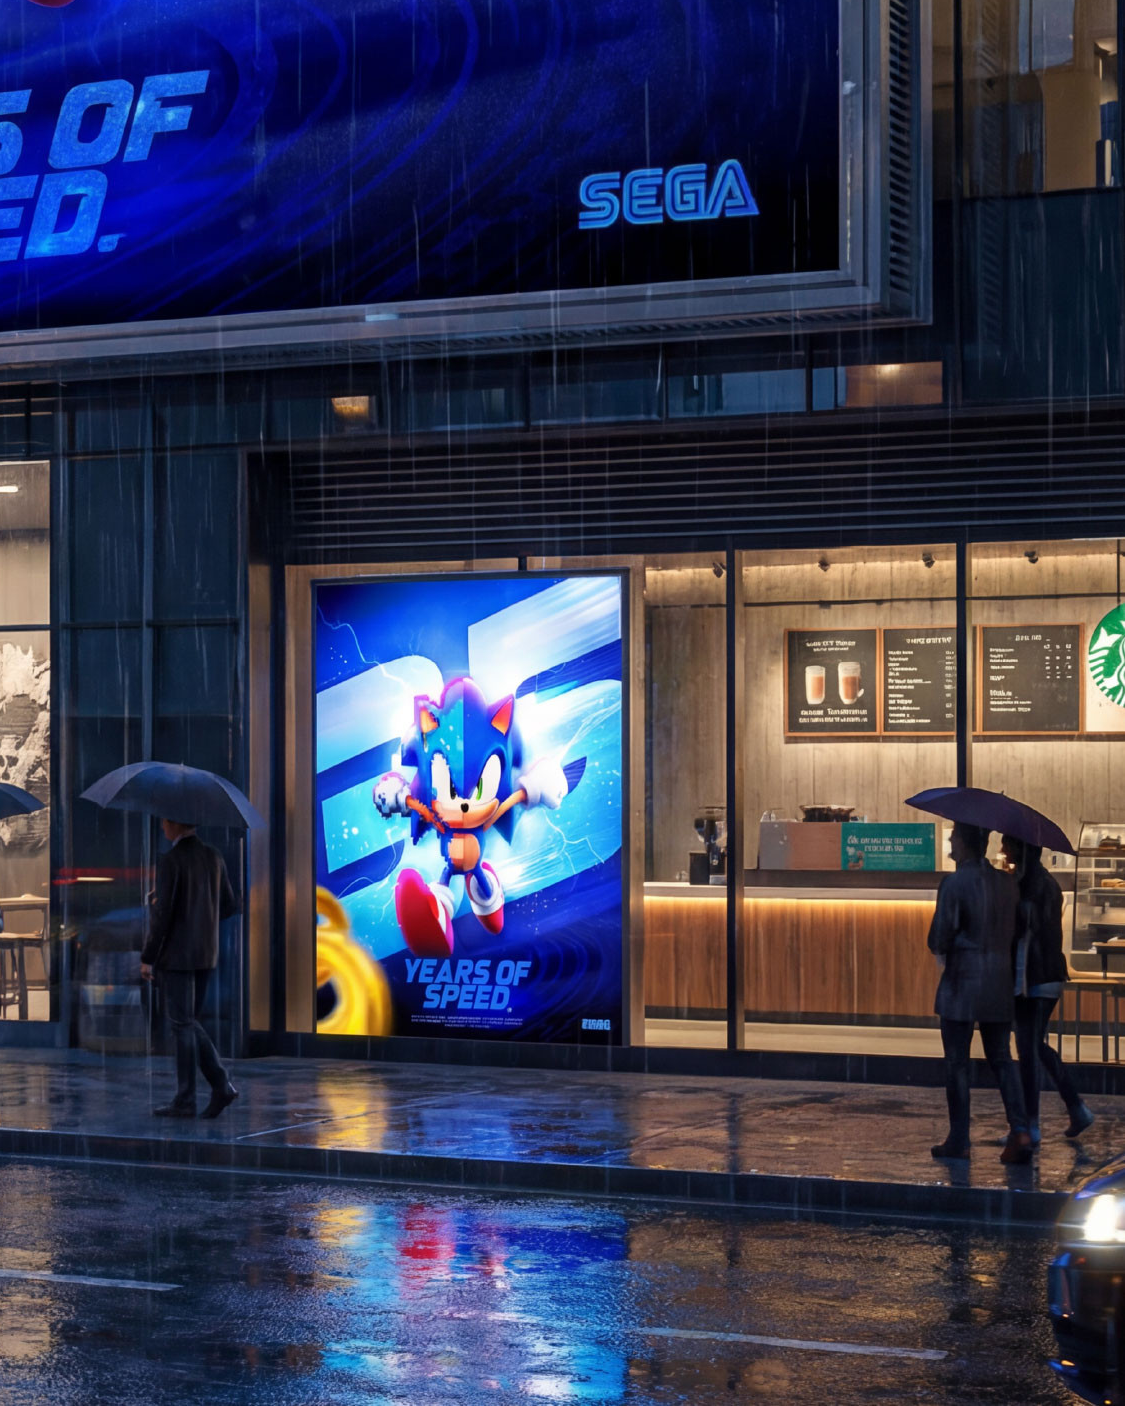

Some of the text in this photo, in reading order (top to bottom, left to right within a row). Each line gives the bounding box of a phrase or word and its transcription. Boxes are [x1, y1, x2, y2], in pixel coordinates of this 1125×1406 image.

[47, 70, 210, 169] OF
[578, 159, 760, 230] SEGA
[404, 958, 532, 986] YEARS OF
